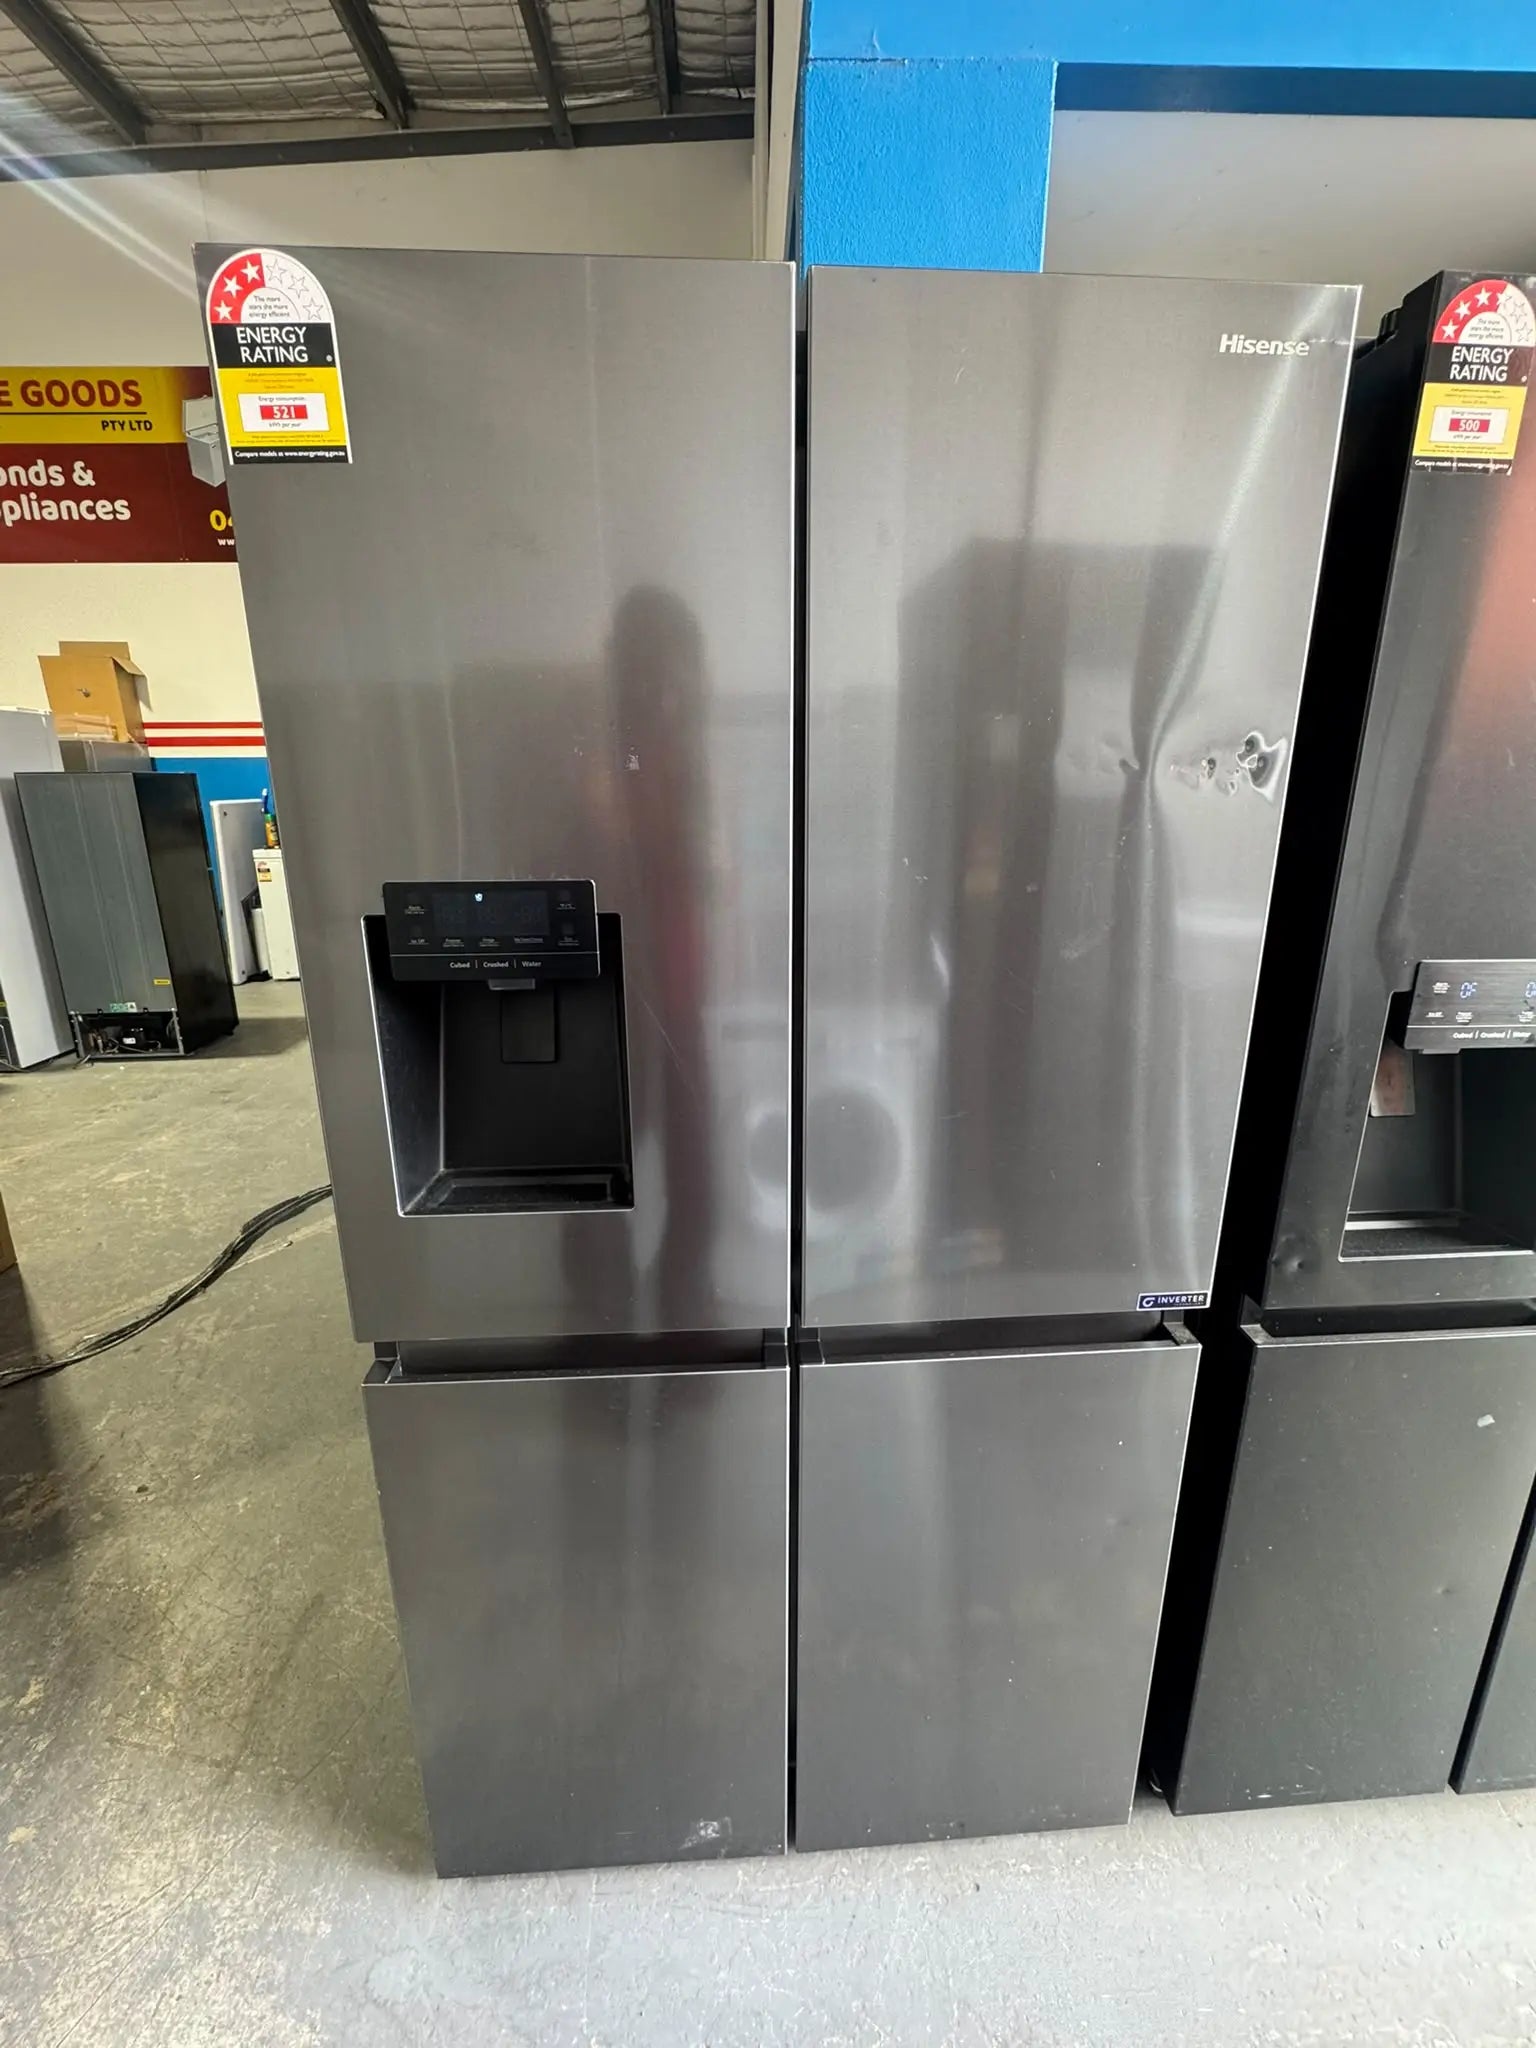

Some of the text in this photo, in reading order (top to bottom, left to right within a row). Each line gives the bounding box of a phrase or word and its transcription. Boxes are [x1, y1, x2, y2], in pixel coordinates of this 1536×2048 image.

[236, 326, 307, 344] ENERGY
[1219, 334, 1310, 356] Hisense
[240, 346, 308, 363] RATING
[1451, 346, 1514, 364] ENERGY
[1450, 364, 1508, 382] RATING
[20, 379, 142, 408] GOODS
[272, 405, 296, 419] 521
[102, 420, 152, 431] PTY LTD
[1458, 420, 1480, 432] 500
[72, 461, 96, 486] &
[0, 492, 131, 527] pliances
[1158, 1295, 1204, 1304] INVERTER
